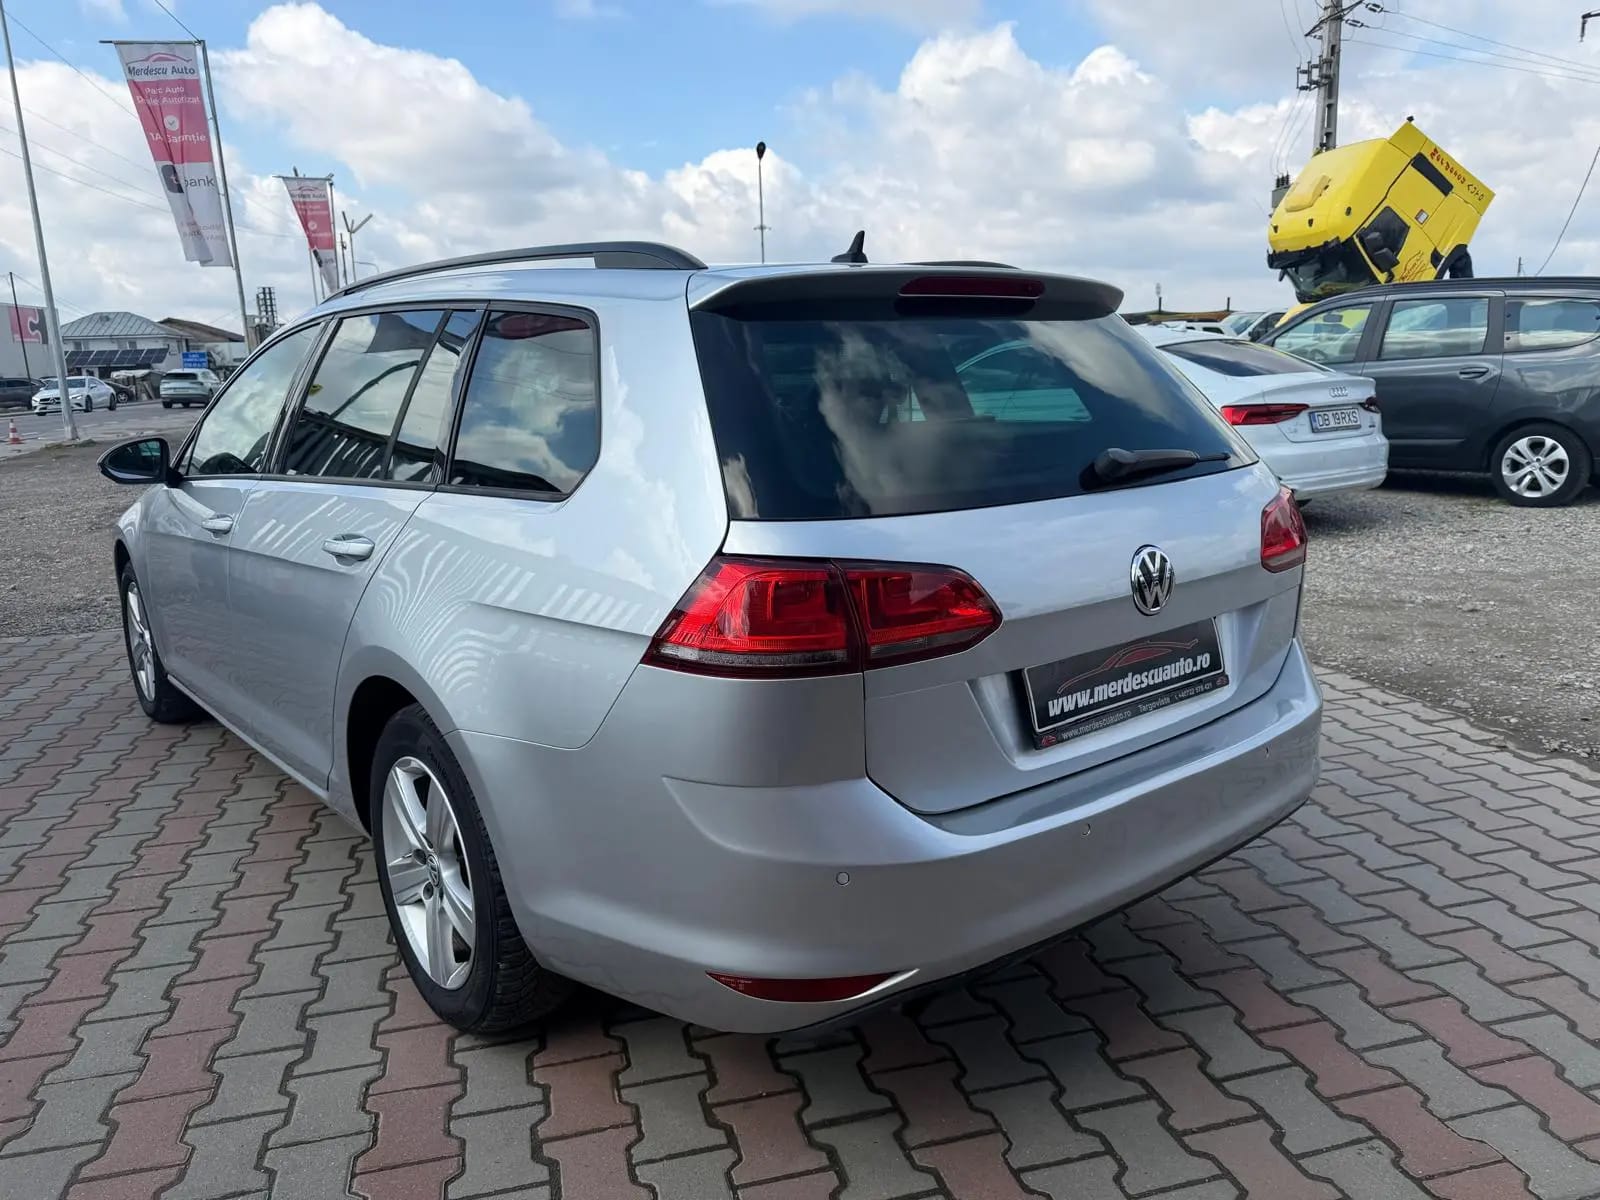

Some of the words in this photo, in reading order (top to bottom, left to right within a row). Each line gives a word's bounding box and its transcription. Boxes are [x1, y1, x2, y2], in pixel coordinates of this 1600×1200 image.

[128, 65, 168, 77] Merdescu
[171, 65, 196, 75] Auto
[165, 86, 185, 94] Auto
[1317, 413, 1330, 427] DB
[1047, 652, 1212, 718] www.merdescuauto.ro
